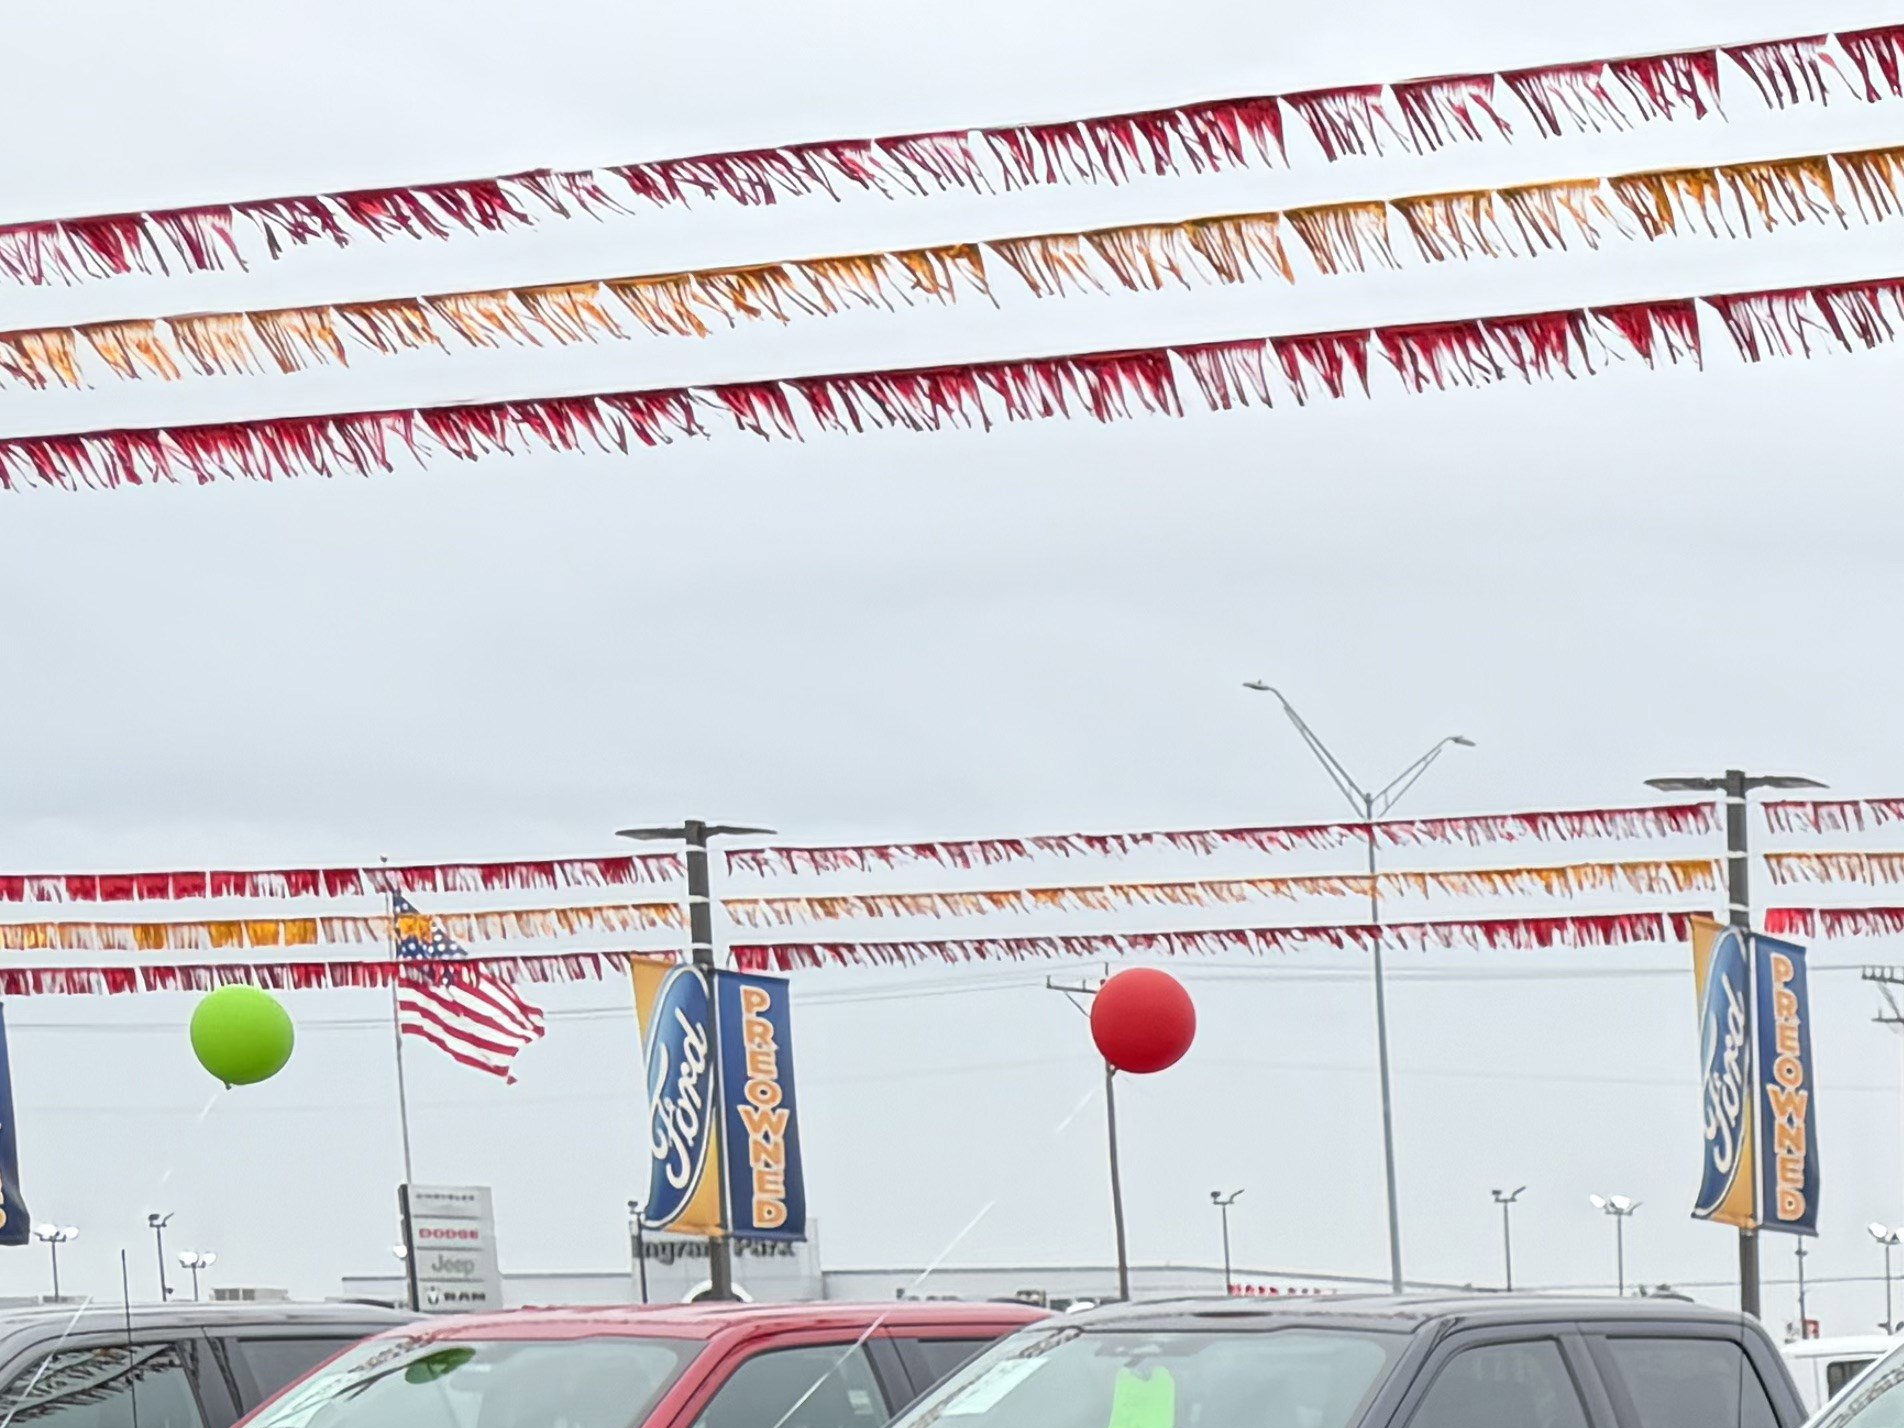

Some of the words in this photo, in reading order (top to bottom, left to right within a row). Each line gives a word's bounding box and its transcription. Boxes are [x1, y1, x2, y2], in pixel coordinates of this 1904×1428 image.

[650, 1006, 709, 1190] Ford
[737, 984, 790, 1229] PREOWNED
[1703, 972, 1746, 1174] Ford
[1766, 952, 1808, 1221] PREOWNED
[419, 1228, 479, 1240] DODGE
[431, 1254, 476, 1280] Jeep
